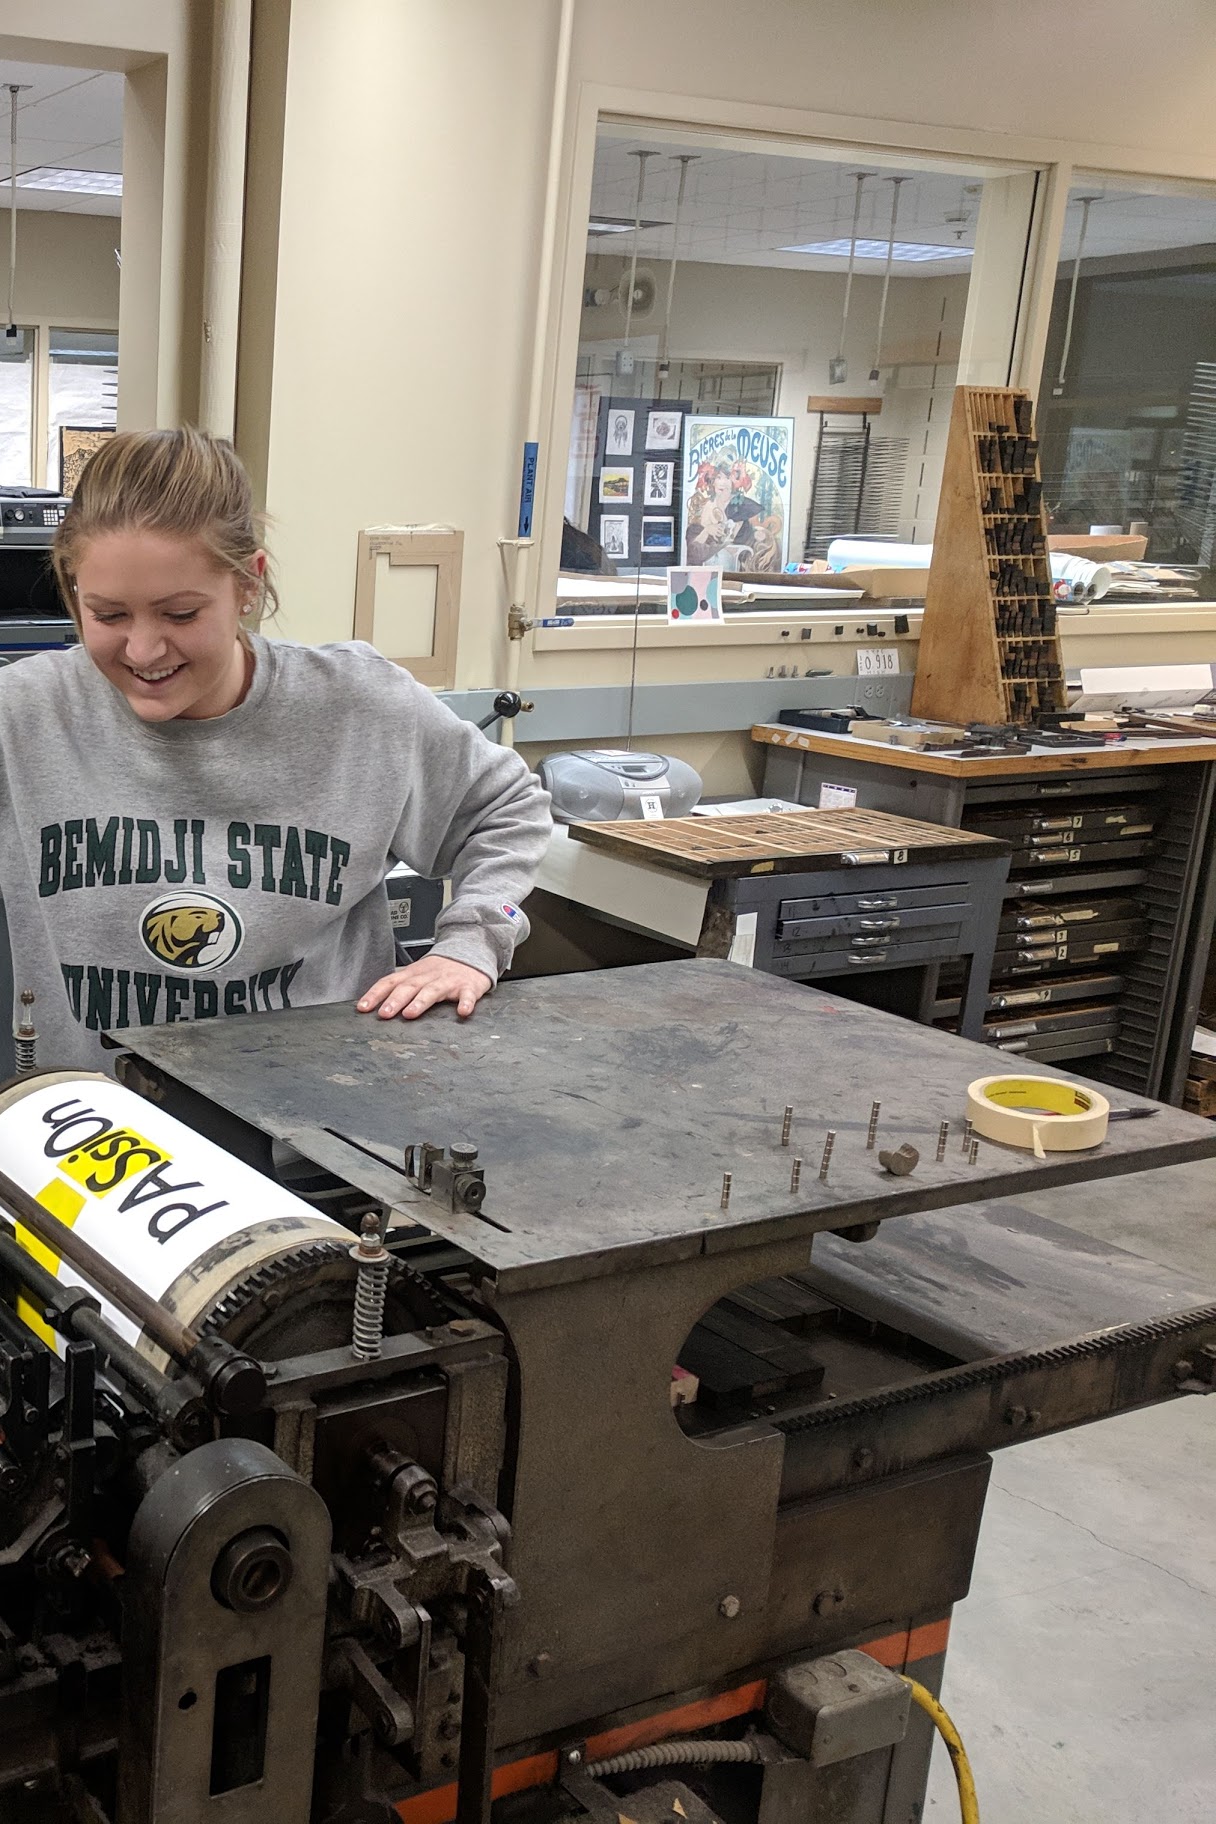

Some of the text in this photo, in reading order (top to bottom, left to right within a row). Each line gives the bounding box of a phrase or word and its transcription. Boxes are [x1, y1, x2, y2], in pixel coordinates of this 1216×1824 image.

[527, 457, 535, 487] PLANT
[737, 428, 788, 488] MEUSE
[39, 816, 350, 906] BEMIDJI STATE
[897, 851, 904, 862] 8
[61, 957, 304, 1030] UNIVERSITY
